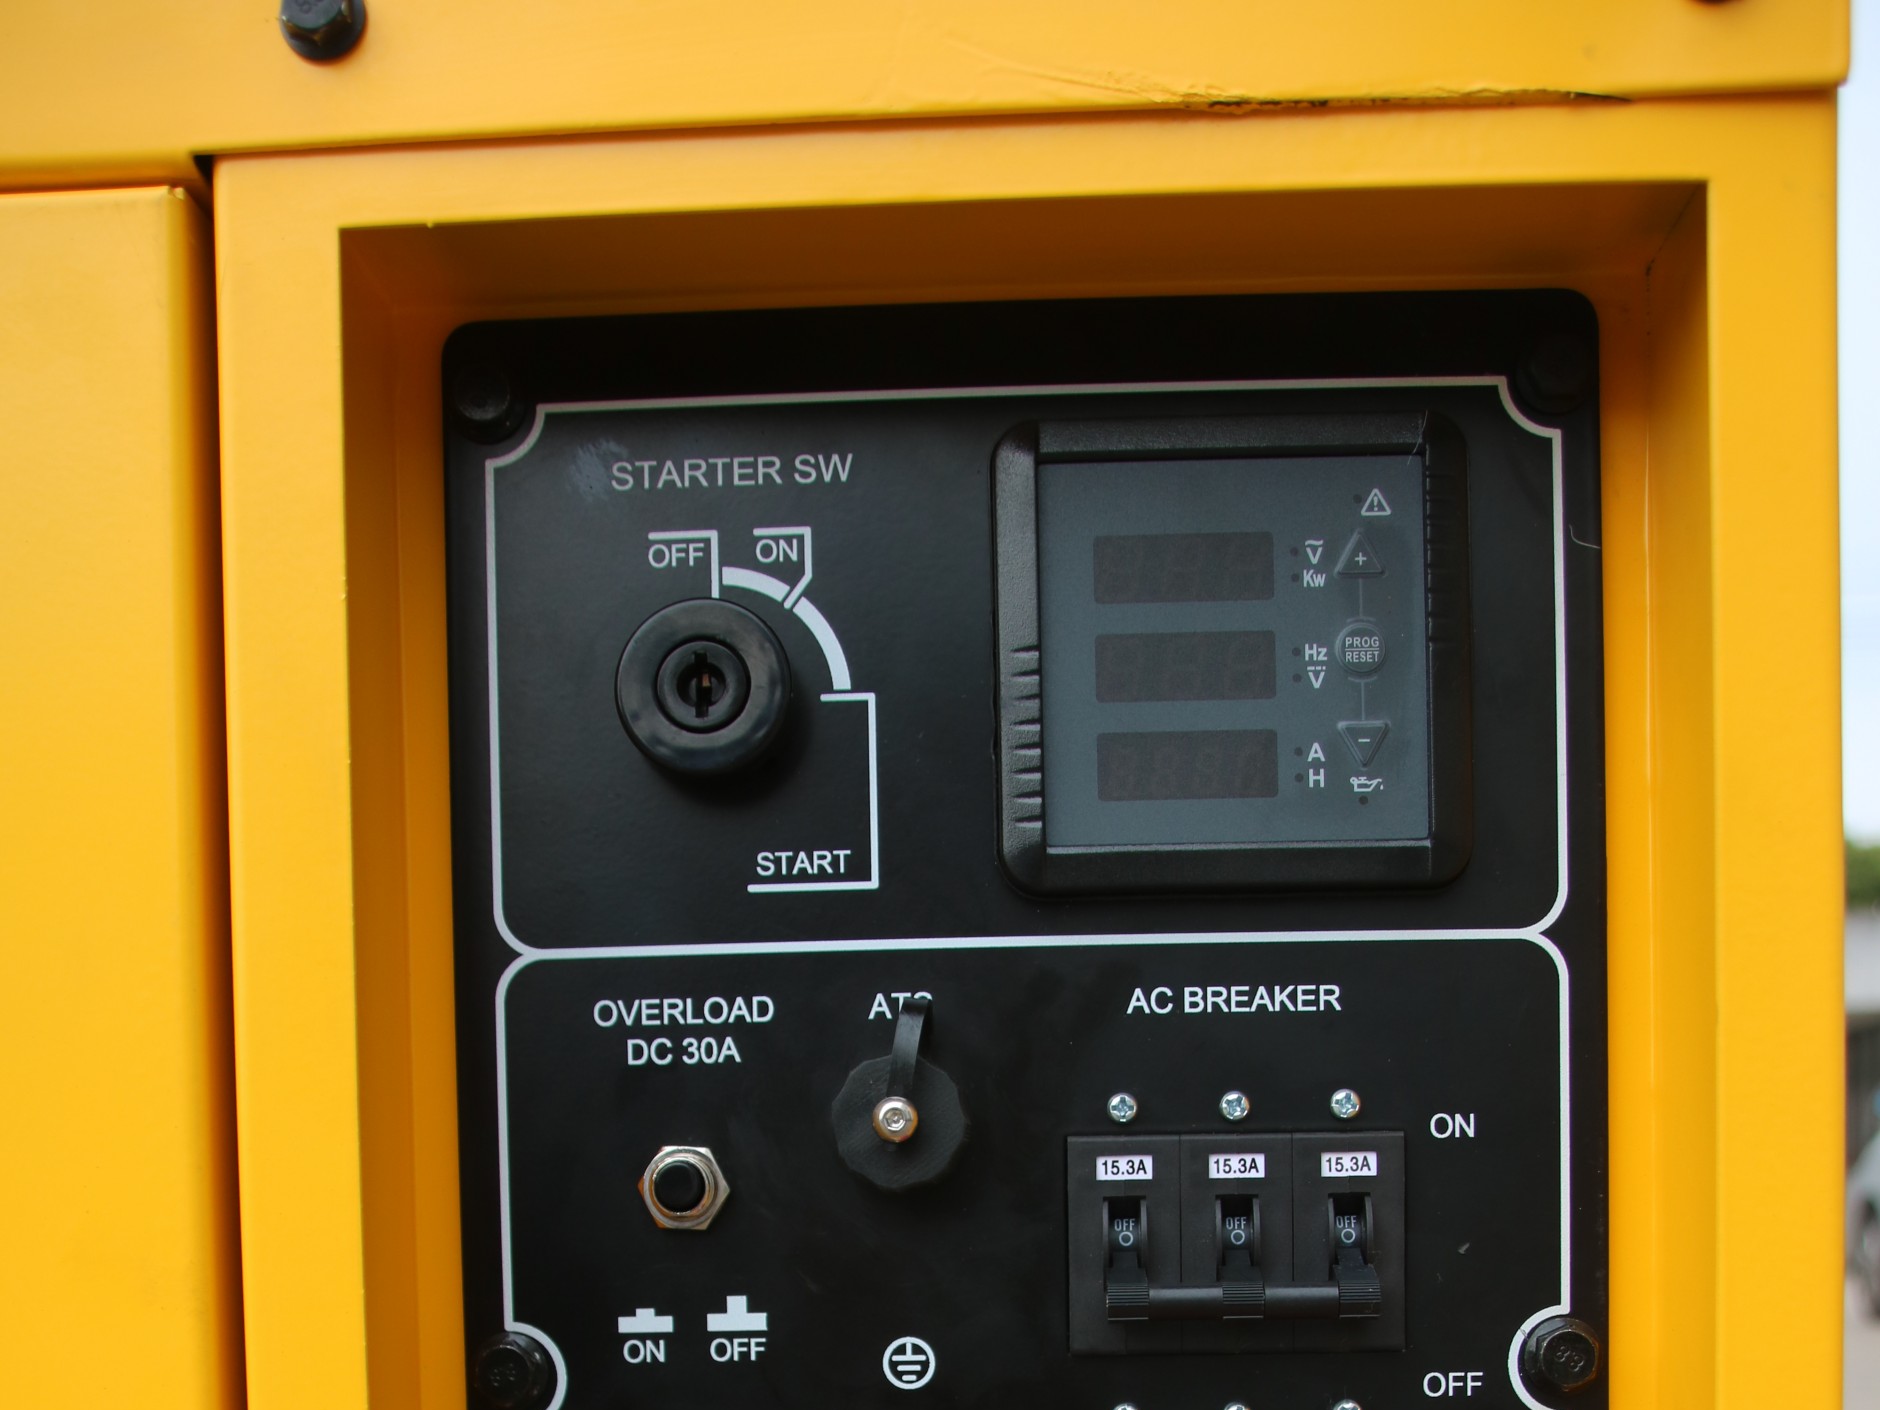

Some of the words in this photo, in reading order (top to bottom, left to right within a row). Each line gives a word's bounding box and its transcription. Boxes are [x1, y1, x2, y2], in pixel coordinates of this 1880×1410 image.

[611, 457, 782, 491] STARTER
[794, 453, 852, 483] SW
[648, 543, 704, 568] OFF
[756, 538, 798, 563] ON
[1305, 643, 1327, 661] Hz
[1345, 636, 1379, 648] PROG
[1345, 651, 1379, 663] RESET
[1307, 742, 1325, 761] A
[1308, 768, 1325, 788] H
[757, 849, 851, 875] START
[593, 996, 774, 1027] OVERLOAD
[868, 991, 932, 1019] AT
[1126, 987, 1173, 1014] AC
[1184, 985, 1341, 1013] BREAKER
[627, 1039, 672, 1065] DC
[681, 1037, 741, 1064] 30A
[1430, 1113, 1475, 1138] ON
[1102, 1159, 1147, 1175] 15.3A
[1214, 1157, 1259, 1173] 15.3A
[1326, 1156, 1371, 1172] 15.3A
[1114, 1218, 1136, 1231] OFF
[1226, 1217, 1247, 1229] OFF
[1336, 1215, 1357, 1228] OFF
[623, 1339, 665, 1363] ON
[710, 1338, 766, 1362] OFF
[1423, 1372, 1483, 1397] OFF
